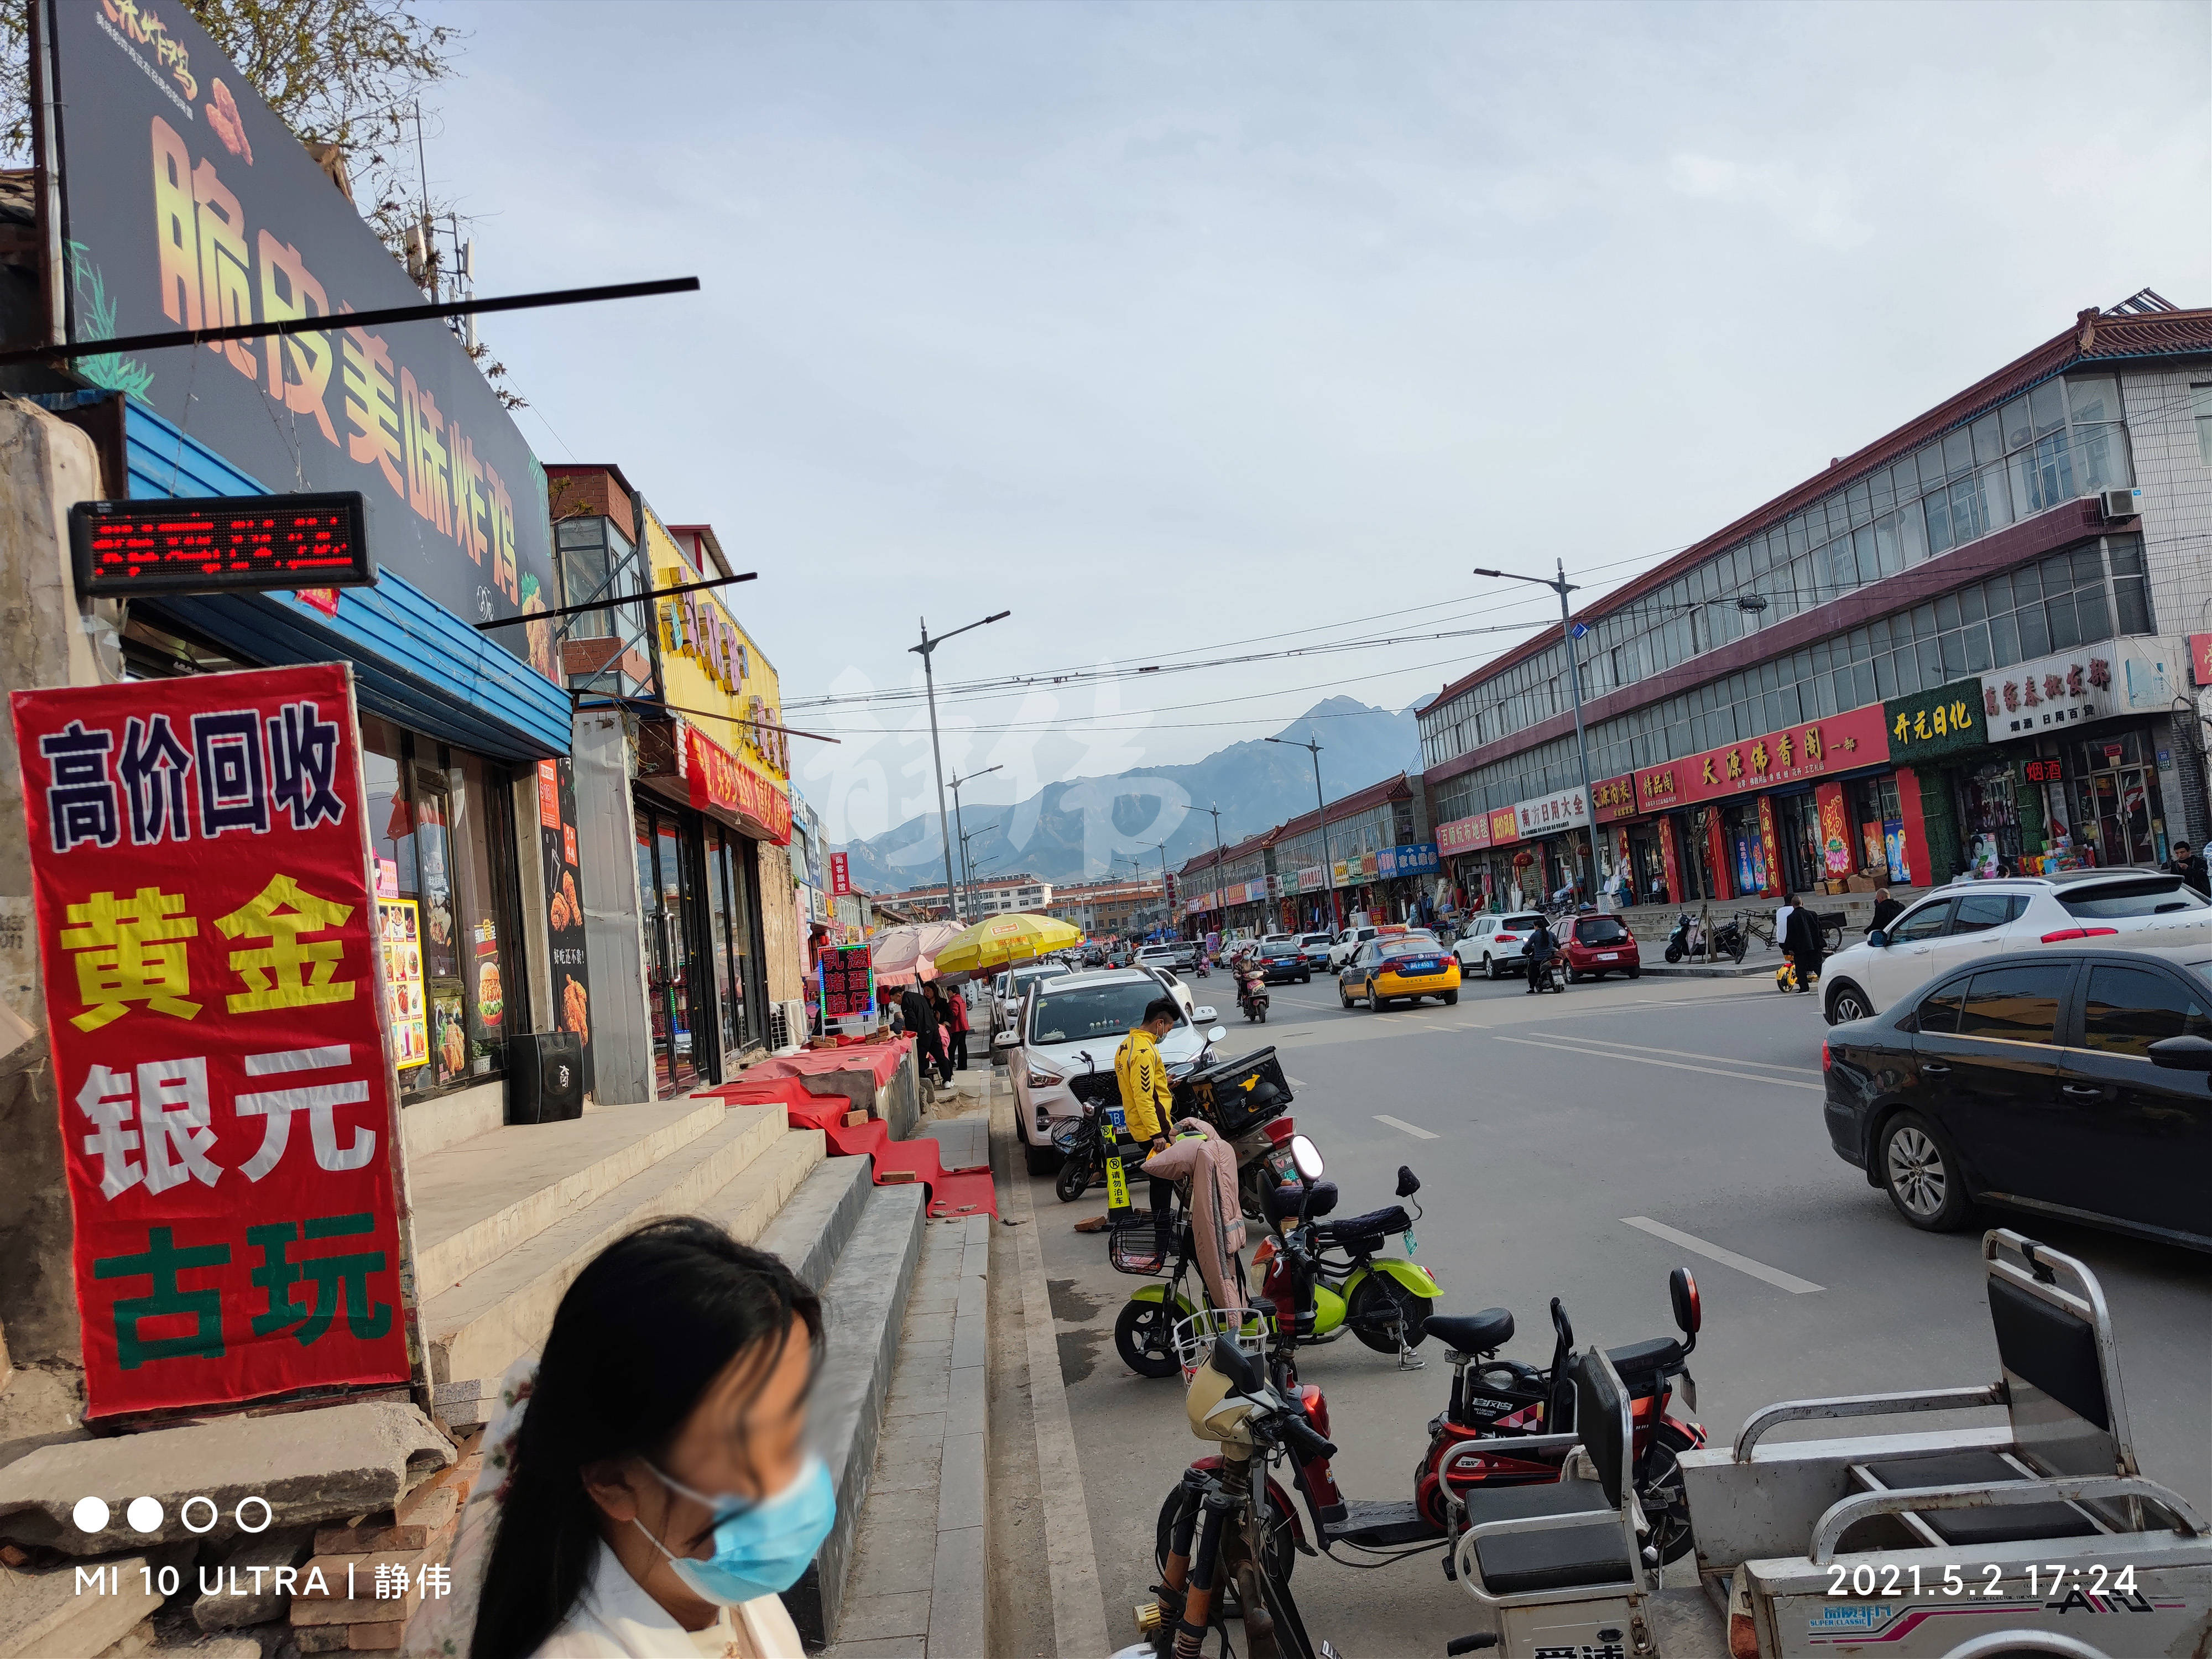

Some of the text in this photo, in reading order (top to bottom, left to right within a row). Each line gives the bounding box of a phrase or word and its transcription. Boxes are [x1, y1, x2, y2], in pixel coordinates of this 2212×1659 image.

[151, 114, 519, 607] 脆皮美味炸鸡
[1893, 700, 1973, 745] 开元日化
[2042, 704, 2094, 725] 日用百货
[40, 701, 347, 853] 高价回收
[1702, 726, 1856, 785] 天源佛香阁 一部
[1804, 761, 1824, 774] 工艺礼品
[2026, 759, 2062, 781] 烟酒
[1642, 770, 1674, 799] 精品阁
[1520, 794, 1584, 828] 南方日用大全
[1398, 852, 1438, 869] 家电维修
[1760, 797, 1778, 889] 天源佛香阁
[836, 855, 847, 891] 尚客旅馆
[60, 873, 356, 1034] 黄金
[554, 948, 585, 965] 好吃还不贵!
[823, 950, 847, 1014] 乳猪蹄
[846, 948, 871, 1013] 滋蛋仔
[75, 1044, 377, 1202] 银元
[1111, 1171, 1124, 1205] 请勿泊车
[94, 1213, 393, 1371] 古玩
